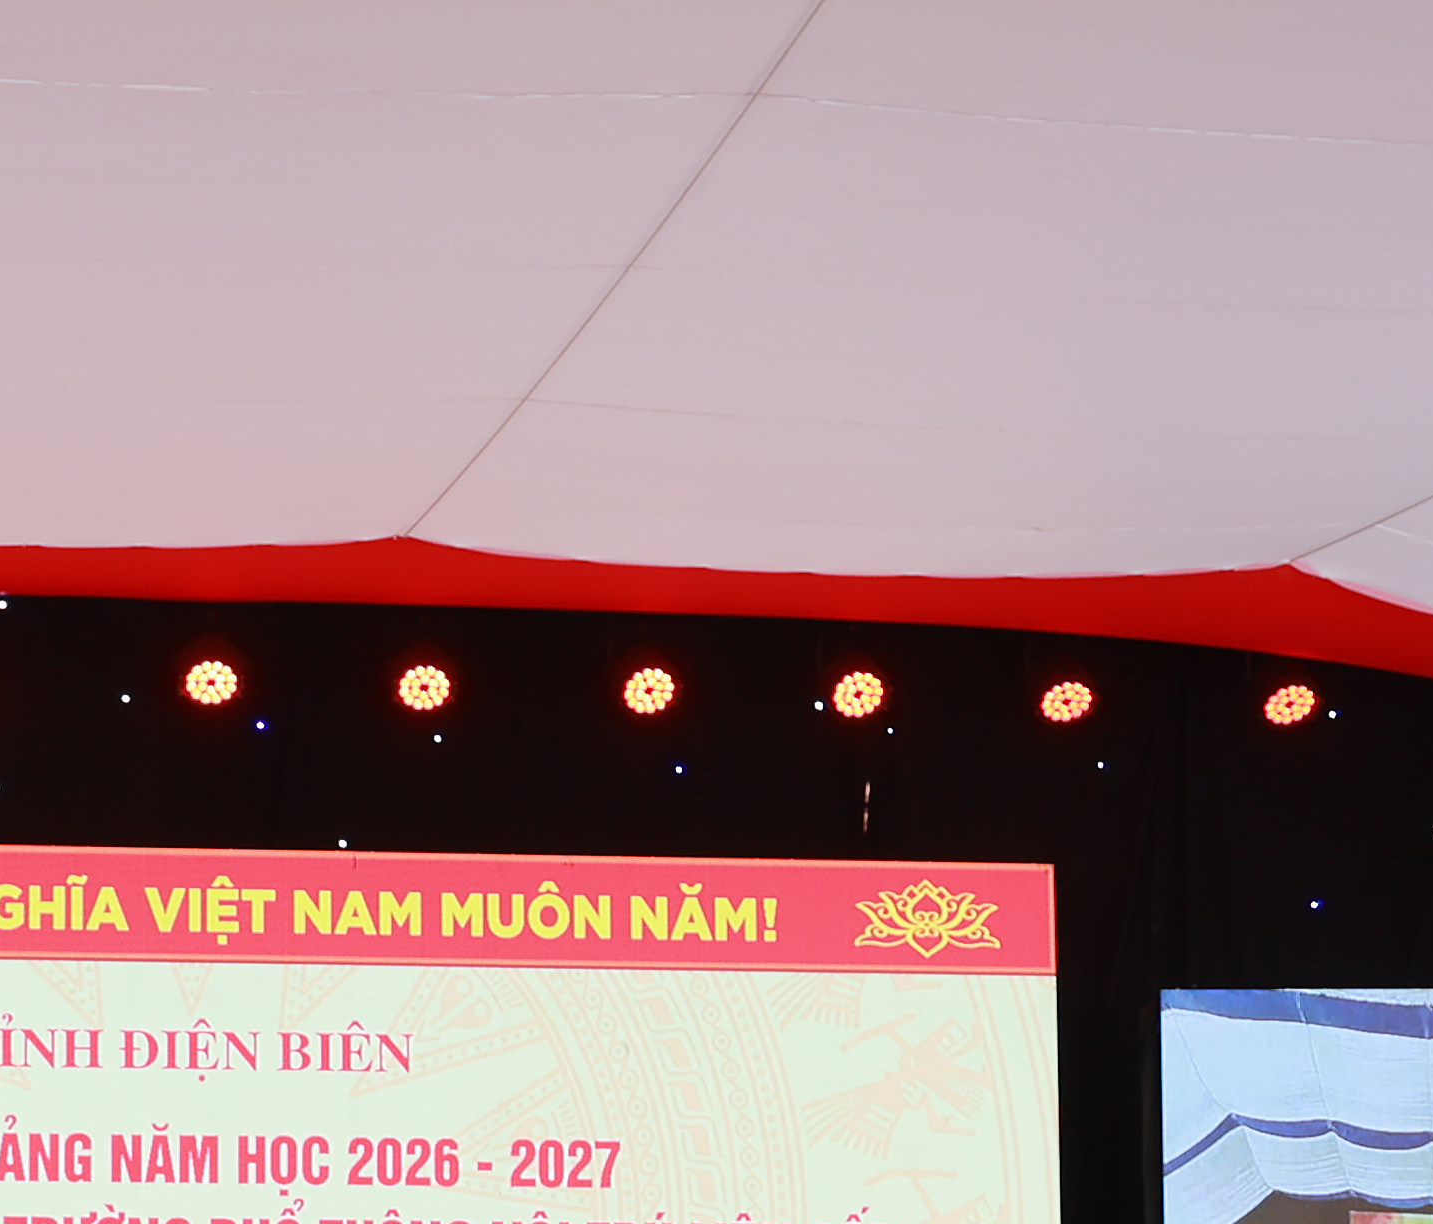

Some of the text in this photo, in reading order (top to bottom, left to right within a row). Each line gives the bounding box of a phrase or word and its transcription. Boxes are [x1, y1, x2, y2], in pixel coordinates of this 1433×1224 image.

[145, 876, 276, 944] VIỆT
[294, 889, 422, 936] NAM
[442, 881, 612, 939] MUÔN
[630, 883, 778, 942] NĂM!
[121, 1018, 257, 1082] ĐIỆN
[279, 1020, 413, 1073] BIÊN
[111, 1123, 219, 1184] NĂM
[238, 1135, 330, 1196] HỌC
[347, 1137, 460, 1187] 2026
[477, 1161, 493, 1171] -
[510, 1139, 621, 1189] 2027
